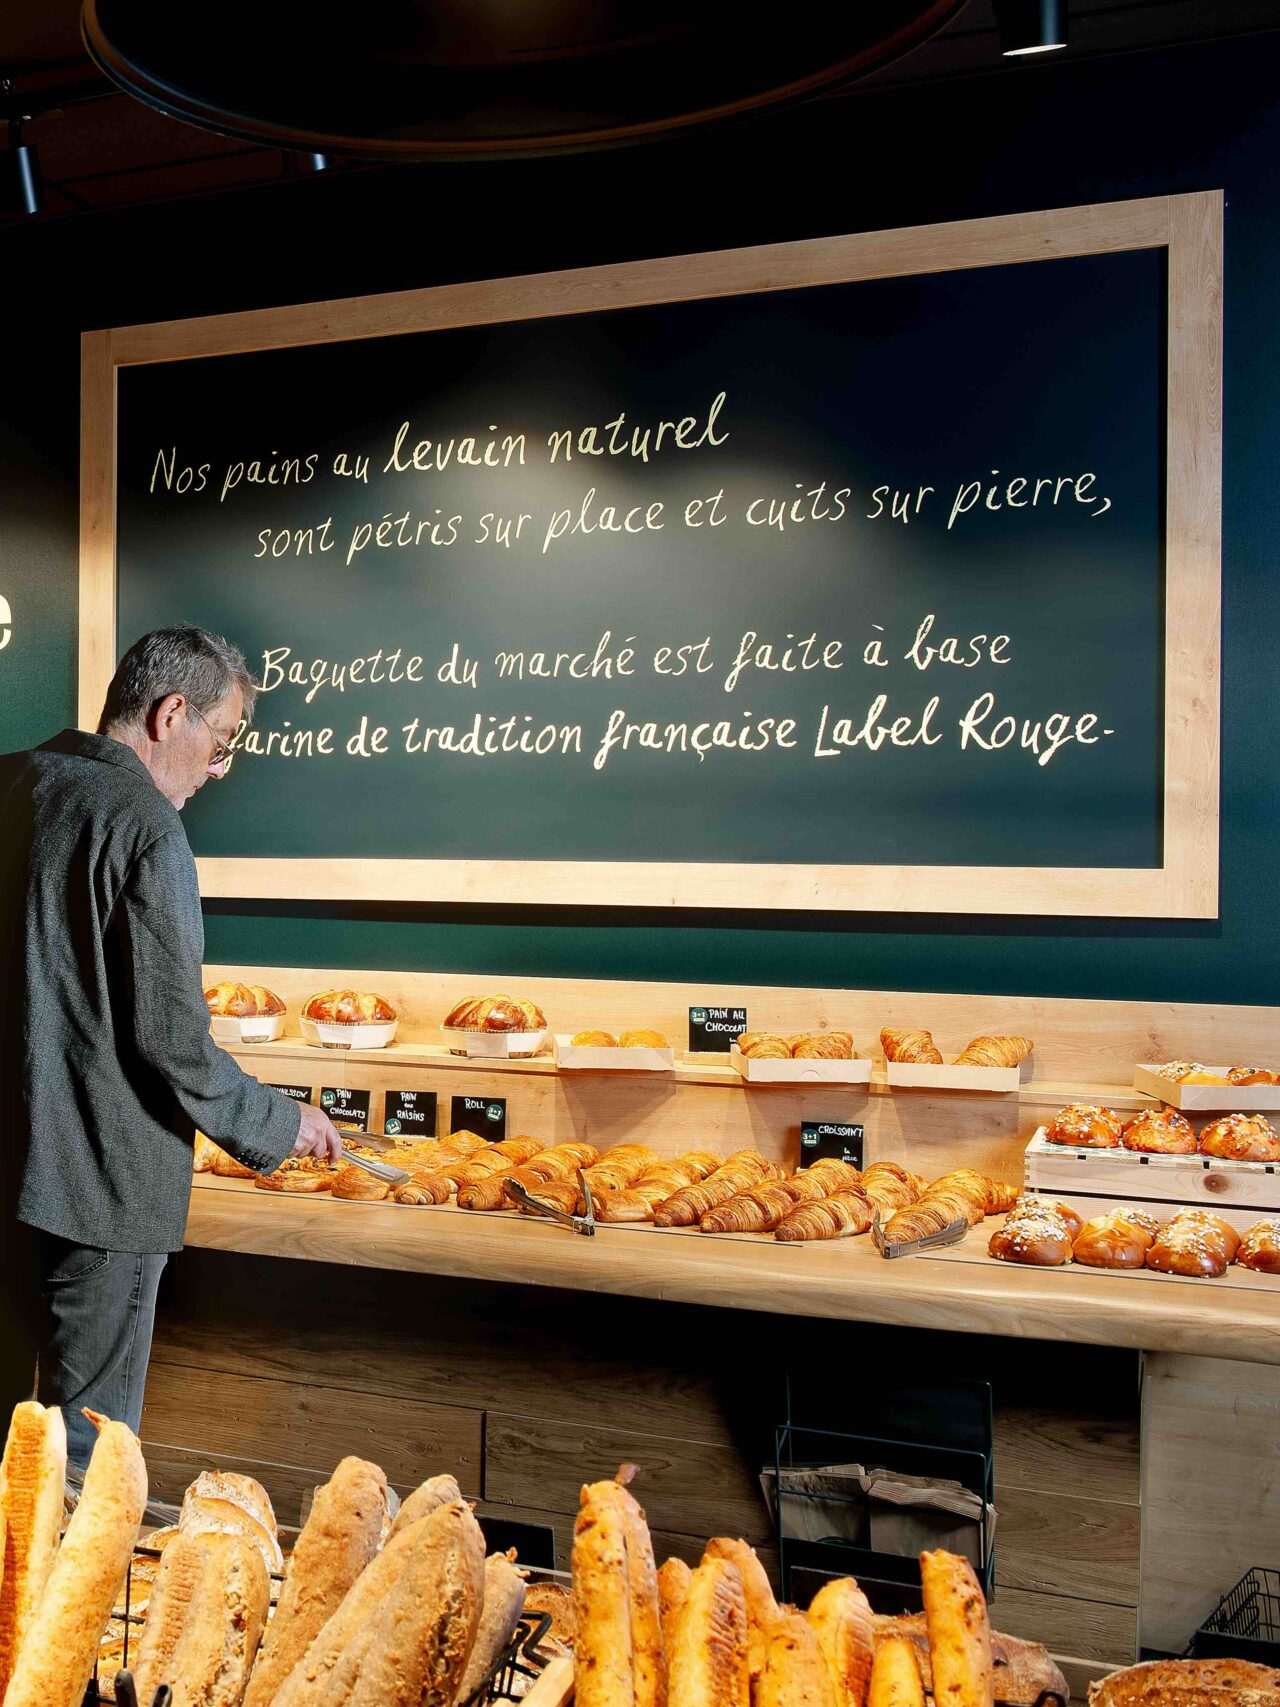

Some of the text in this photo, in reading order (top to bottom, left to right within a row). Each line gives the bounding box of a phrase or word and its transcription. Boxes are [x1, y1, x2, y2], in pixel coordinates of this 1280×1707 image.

[150, 391, 730, 502] Nos pains au levain naturel
[254, 469, 1112, 565] sont pétris sur place et cuits sur pierre,
[256, 615, 1012, 703] Baguette du marché est faite à base
[346, 716, 389, 757] de
[402, 714, 582, 755] tradition
[593, 709, 798, 770] française
[814, 694, 943, 757] Label
[708, 1008, 728, 1019] PAIN
[733, 1010, 745, 1019] AU
[705, 1021, 746, 1033] CHOCOLAT
[336, 1089, 352, 1099] PAIN
[400, 1092, 417, 1101] PAIN
[340, 1099, 346, 1107] 3
[464, 1098, 485, 1109] ROLL
[330, 1107, 365, 1118] CHOCOLATS
[396, 1110, 425, 1121] RAISINS
[489, 1107, 501, 1116] 3+1
[387, 1121, 399, 1130] 3+1
[818, 1125, 864, 1137] CROISSANT
